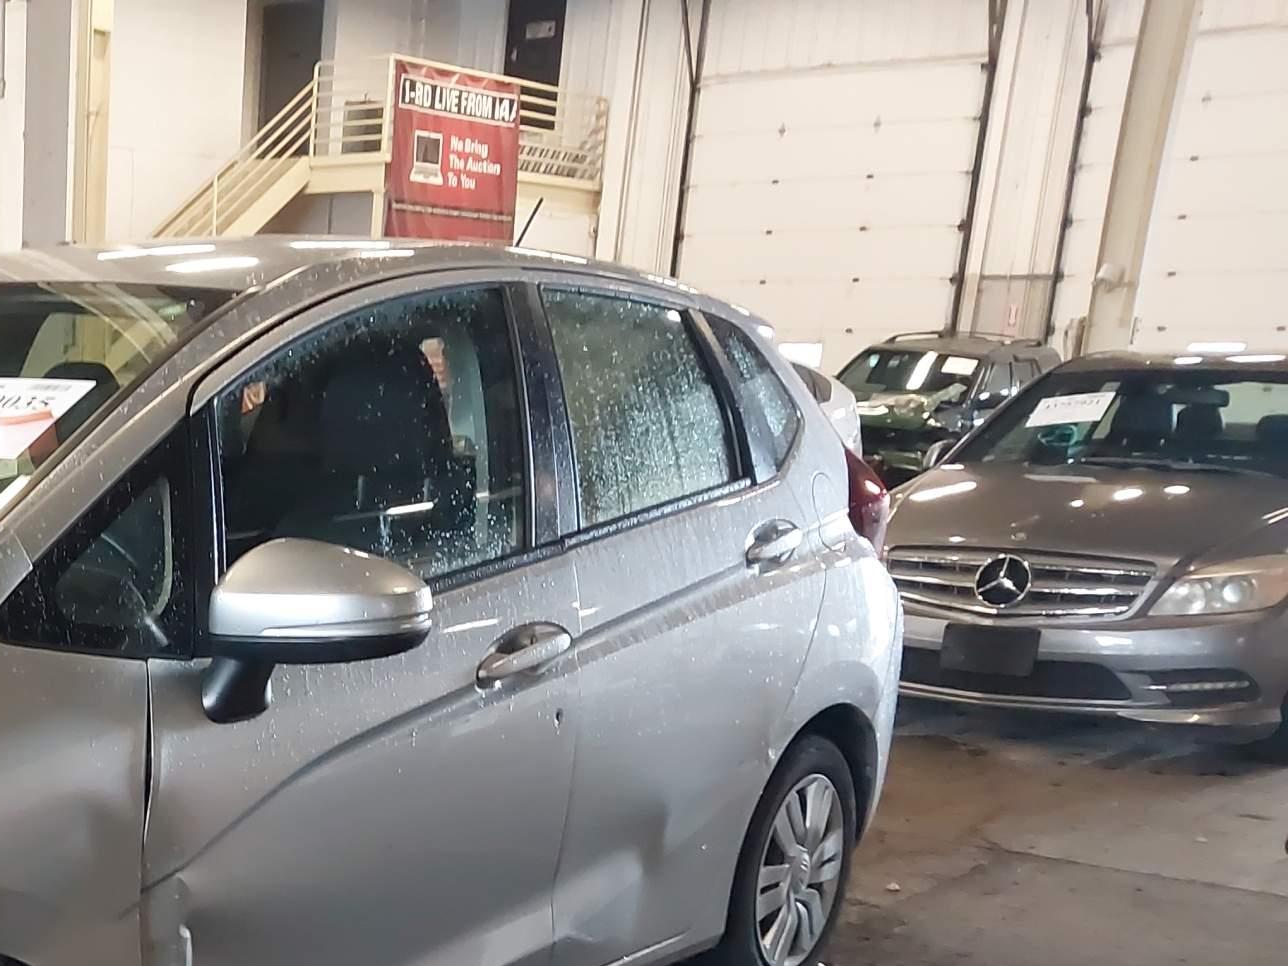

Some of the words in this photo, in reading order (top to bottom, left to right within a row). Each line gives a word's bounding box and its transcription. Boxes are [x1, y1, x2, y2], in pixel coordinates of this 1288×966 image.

[434, 84, 459, 114] LIVE
[461, 91, 492, 119] FROM
[449, 154, 464, 171] The
[466, 156, 501, 175] Auction
[447, 171, 457, 188] To
[461, 173, 476, 190] You
